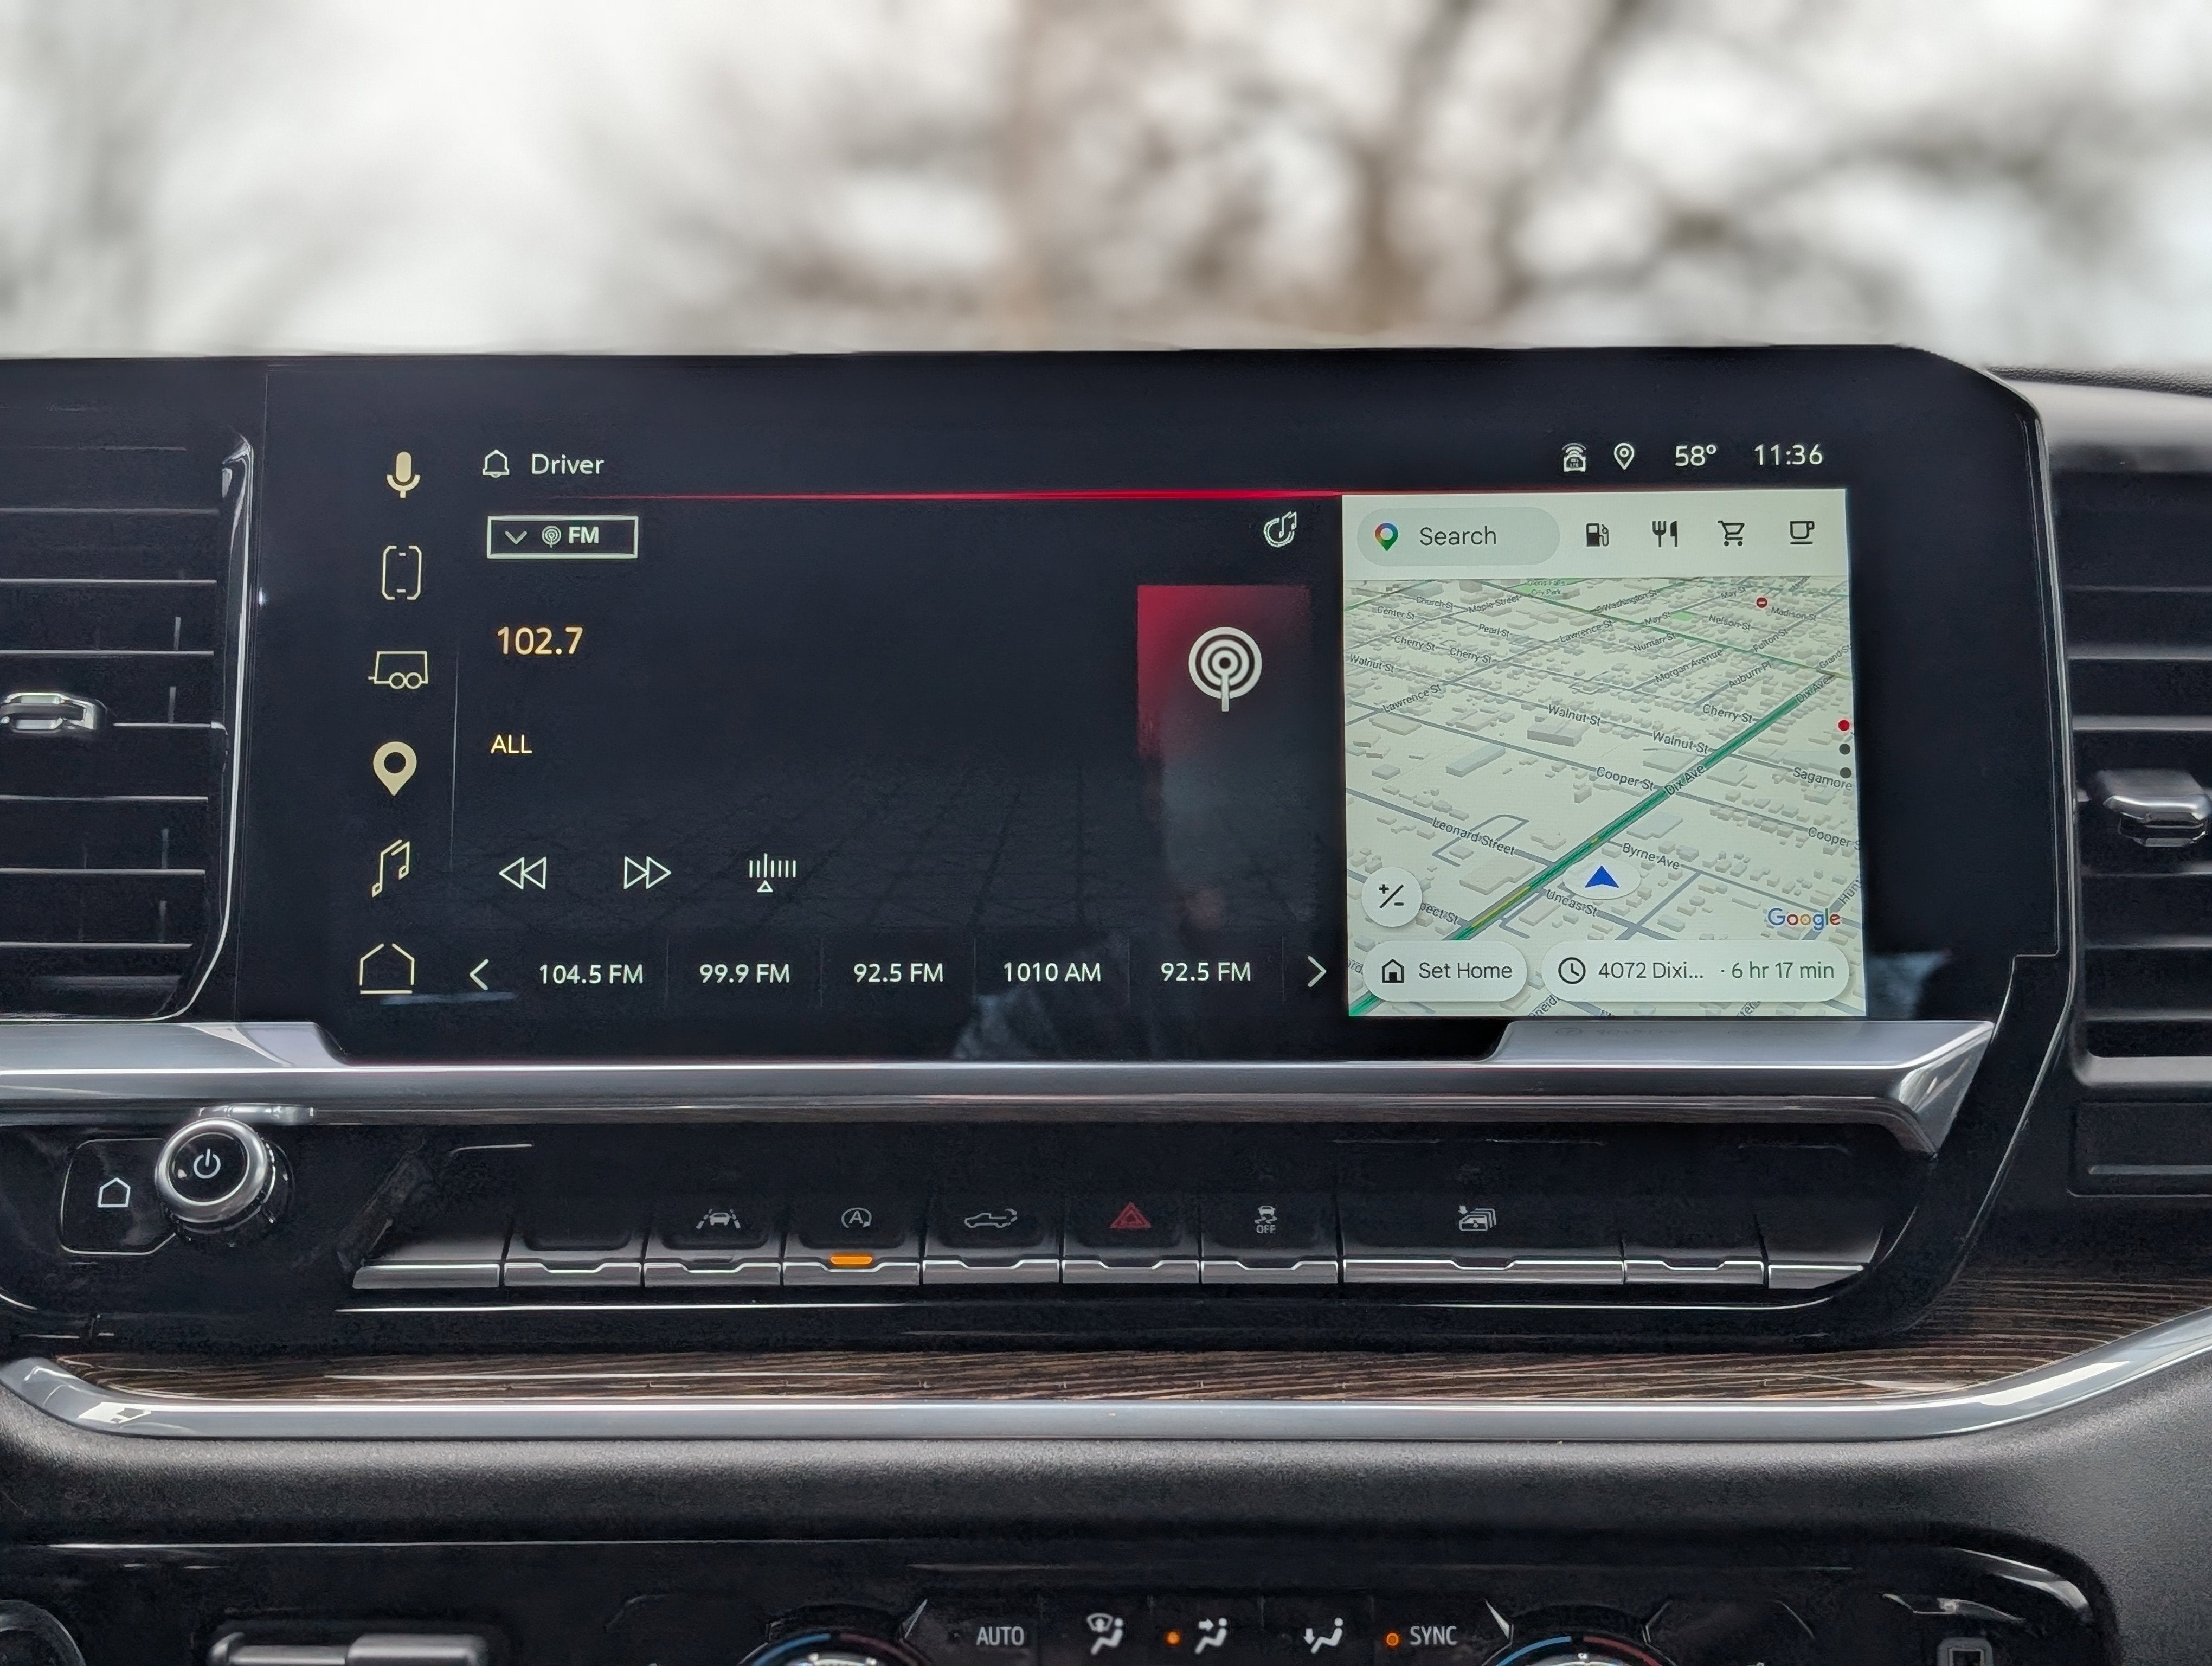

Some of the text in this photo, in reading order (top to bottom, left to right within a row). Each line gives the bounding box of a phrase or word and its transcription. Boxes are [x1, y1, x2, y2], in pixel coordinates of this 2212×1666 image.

[531, 453, 605, 475] Driver
[1675, 444, 1717, 467] 58°
[1754, 444, 1823, 466] 11:36
[568, 526, 600, 544] FM
[1419, 526, 1497, 546] Search
[1377, 606, 1415, 620] Center St
[1468, 595, 1520, 613] Maple Street
[1771, 606, 1816, 621] Madison St
[1644, 611, 1671, 625] May St
[1708, 614, 1751, 631] Nelson St
[497, 626, 583, 655] 102.7
[1478, 624, 1510, 638] Pearl St
[1559, 620, 1613, 643] Lawrence St
[1752, 627, 1789, 652] Fulton St
[1394, 635, 1436, 651] Cherry St
[1633, 632, 1676, 652] Numan St
[1350, 653, 1395, 673] Walnut St
[1449, 647, 1492, 664] Cherry St
[1819, 650, 1843, 669] Grand
[1654, 649, 1724, 683] Morgan Avenue
[1728, 661, 1772, 688] Auburn Pl
[1382, 684, 1442, 713] Lawrence St
[1795, 676, 1831, 703] Dix Ave
[1549, 704, 1601, 727] Walnut St
[1702, 704, 1752, 724] Cherry St
[490, 734, 533, 754] ALL
[1652, 731, 1709, 754] Walnut St
[1596, 766, 1654, 791] Cooper St
[1664, 765, 1705, 796] Dix Ave
[1792, 767, 1853, 791] Sagamore
[1432, 817, 1515, 856] Leonard Street
[1808, 826, 1852, 848] Cooper
[1622, 842, 1680, 870] Byrne Ave
[1546, 889, 1597, 917] Uncas St
[1445, 912, 1458, 925] St
[1767, 907, 1841, 931] Google
[539, 964, 644, 984] 104.5 FM
[699, 963, 790, 984] 99.9 FM
[853, 963, 944, 983] 92.5 FM
[1003, 962, 1102, 982] 1010 AM
[1161, 962, 1251, 982] 92.5 FM
[1418, 962, 1513, 979] Set Home
[1598, 961, 1703, 979] 4072 Dixi...
[1731, 960, 1835, 979] 6 hr 17 min
[1256, 1224, 1276, 1234] OFF
[976, 1626, 1024, 1646] AUTO
[1410, 1625, 1457, 1646] SYNC
